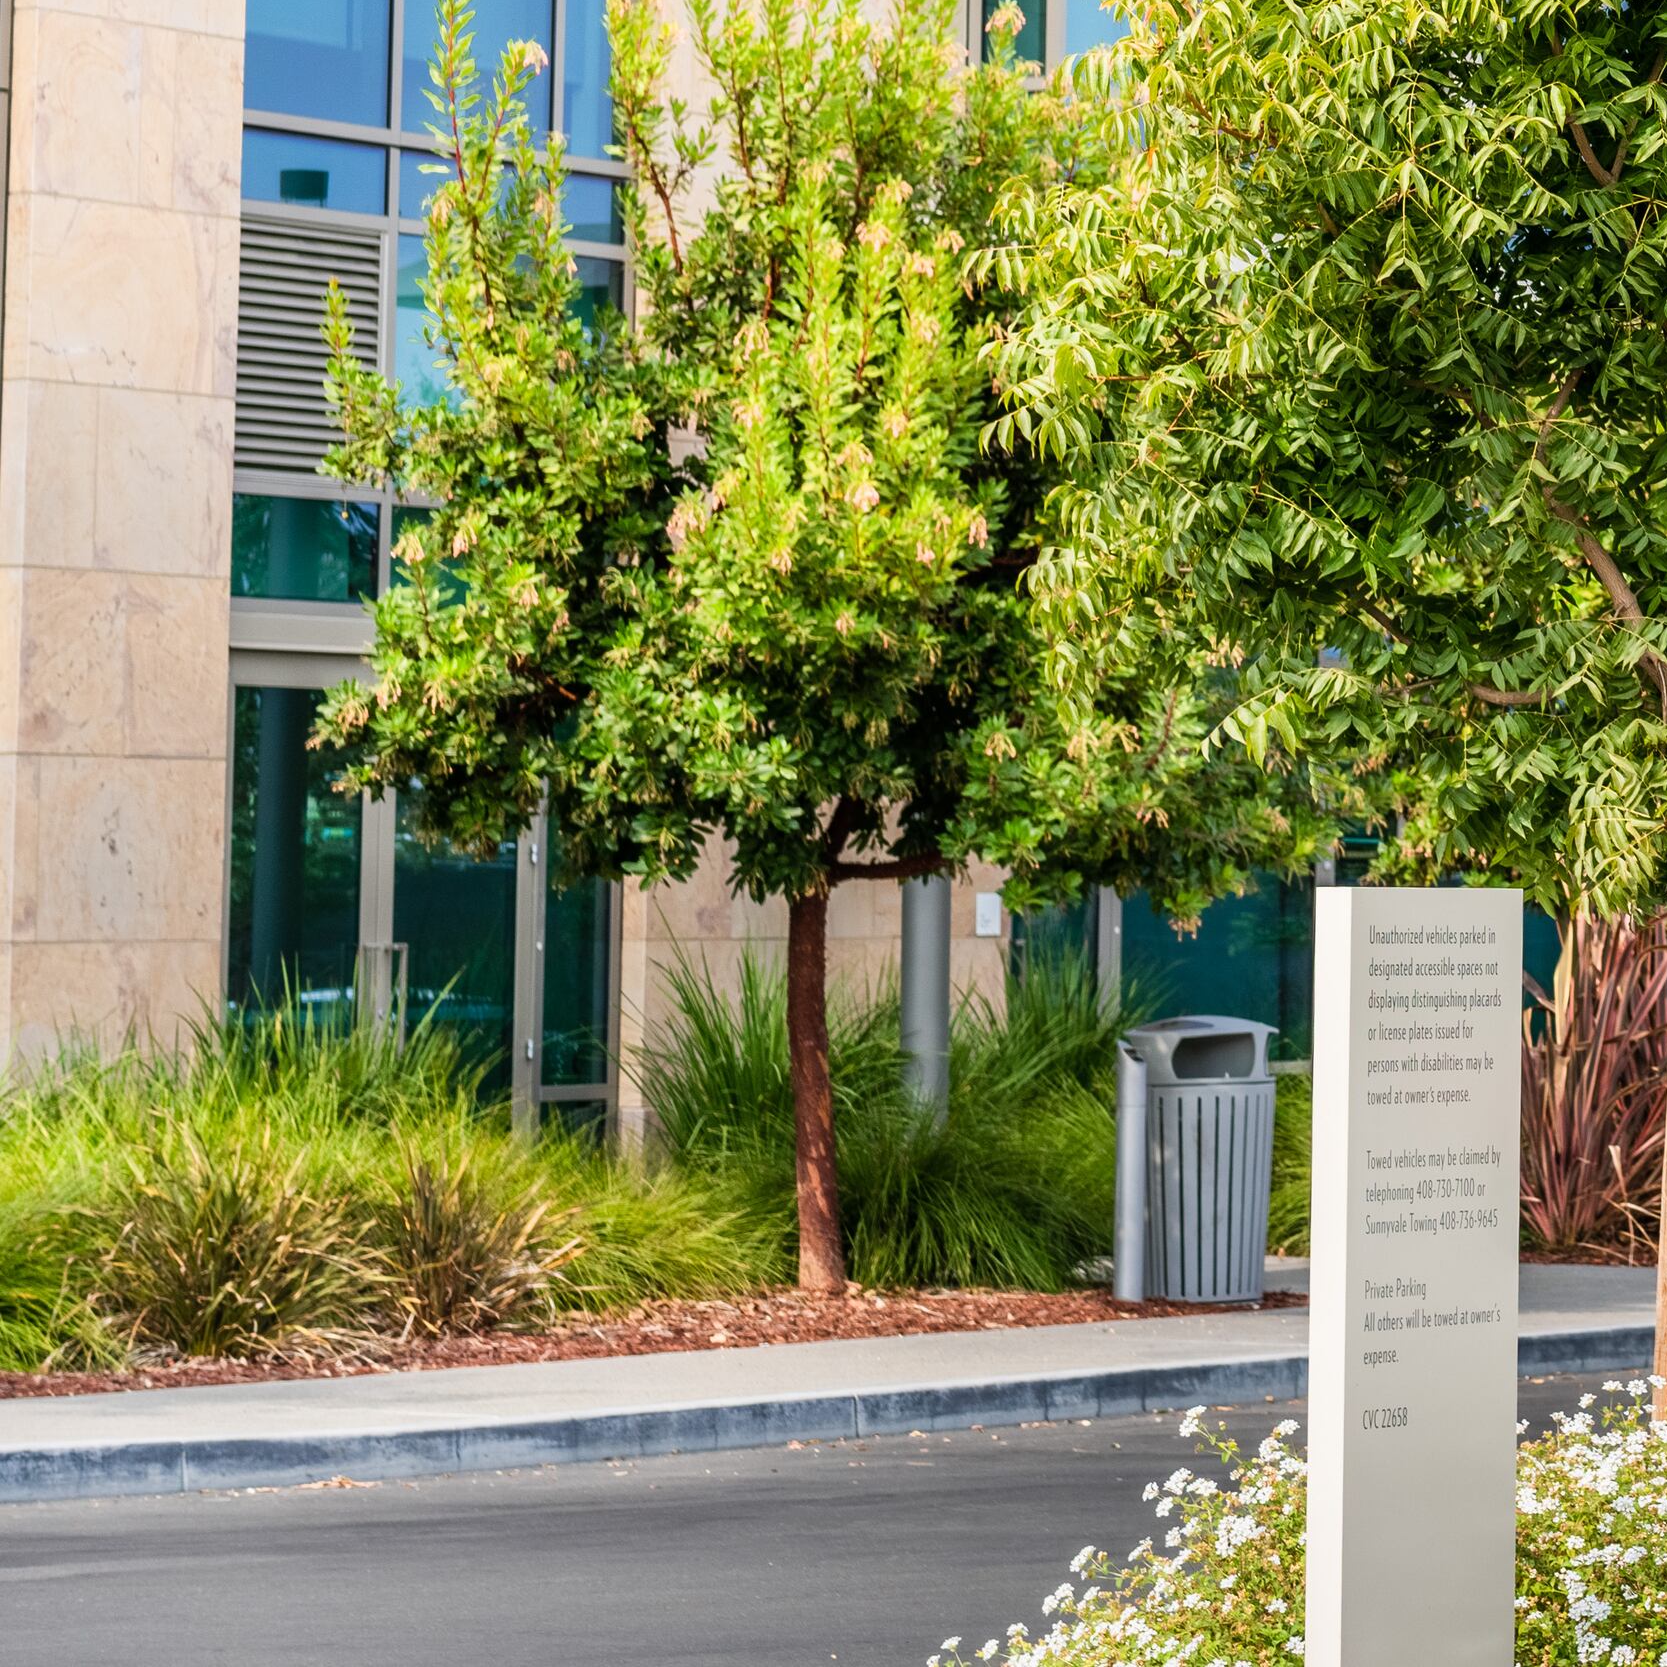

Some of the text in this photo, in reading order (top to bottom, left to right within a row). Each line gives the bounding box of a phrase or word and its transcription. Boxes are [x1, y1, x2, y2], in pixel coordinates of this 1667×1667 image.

[1369, 925, 1496, 948] Unauthorized vehicles parked in
[1368, 957, 1498, 981] designated accessible spaces not
[1368, 988, 1501, 1013] displaying distinguishing placards
[1368, 1019, 1474, 1044] or license plates issued for
[1368, 1051, 1494, 1077] persons with disabilities may be
[1367, 1085, 1392, 1105] towed
[1394, 1090, 1403, 1104] at
[1437, 1089, 1471, 1106] expense.
[1366, 1145, 1501, 1170] Towed vehicles may be claimed by
[1366, 1178, 1486, 1205] telephoning 408-730-7100 or
[1365, 1208, 1498, 1238] Sunnyvale Towing 408-736-9645
[1365, 1277, 1426, 1300] Private Parking
[1363, 1312, 1375, 1332] All
[1377, 1311, 1403, 1331] others
[1405, 1308, 1420, 1329] will
[1422, 1308, 1432, 1328] be
[1434, 1306, 1458, 1327] towed
[1460, 1310, 1468, 1325] at
[1363, 1349, 1399, 1369] expense.
[1362, 1407, 1408, 1430] CVC 22658
